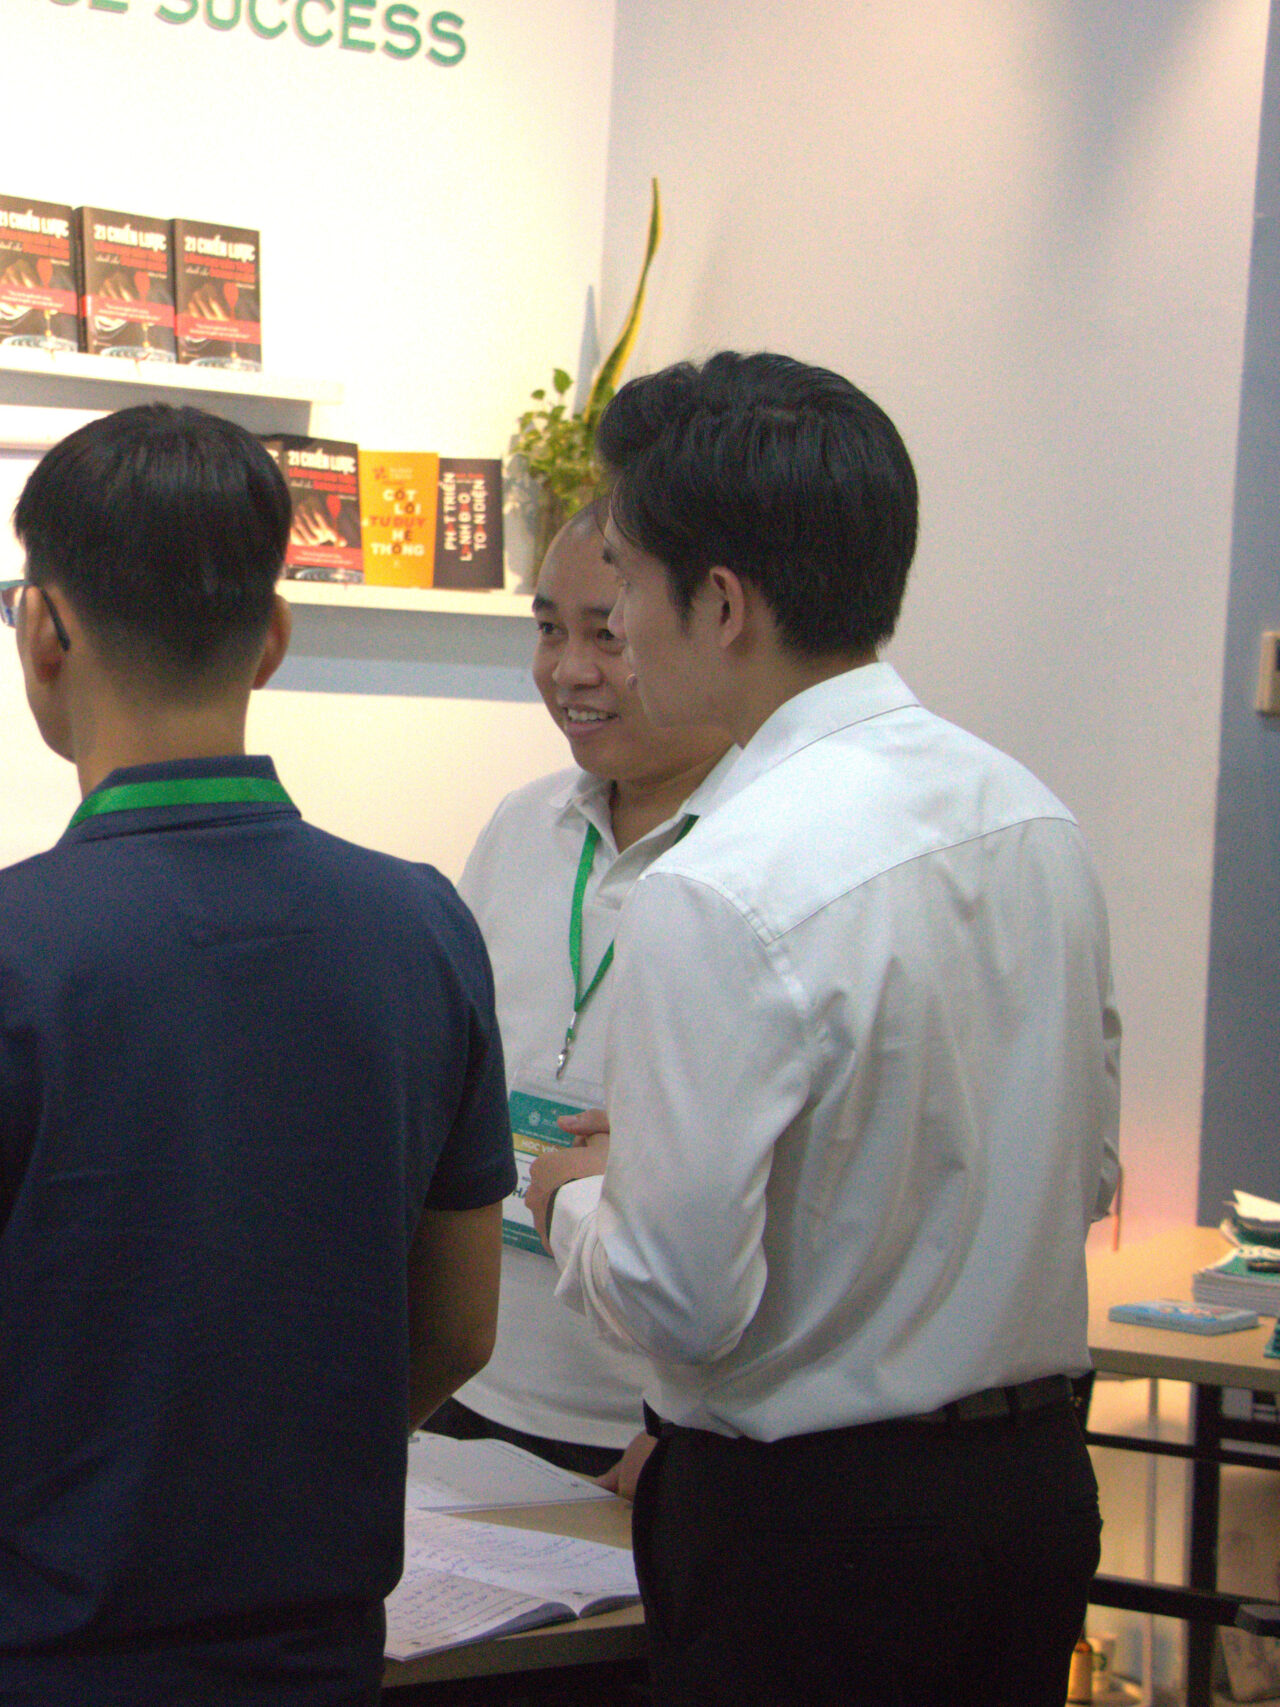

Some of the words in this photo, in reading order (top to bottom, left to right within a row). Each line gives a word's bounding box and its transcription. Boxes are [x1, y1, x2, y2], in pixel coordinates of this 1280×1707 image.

[93, 223, 107, 240] 21
[183, 235, 196, 252] 21
[287, 449, 300, 466] 21
